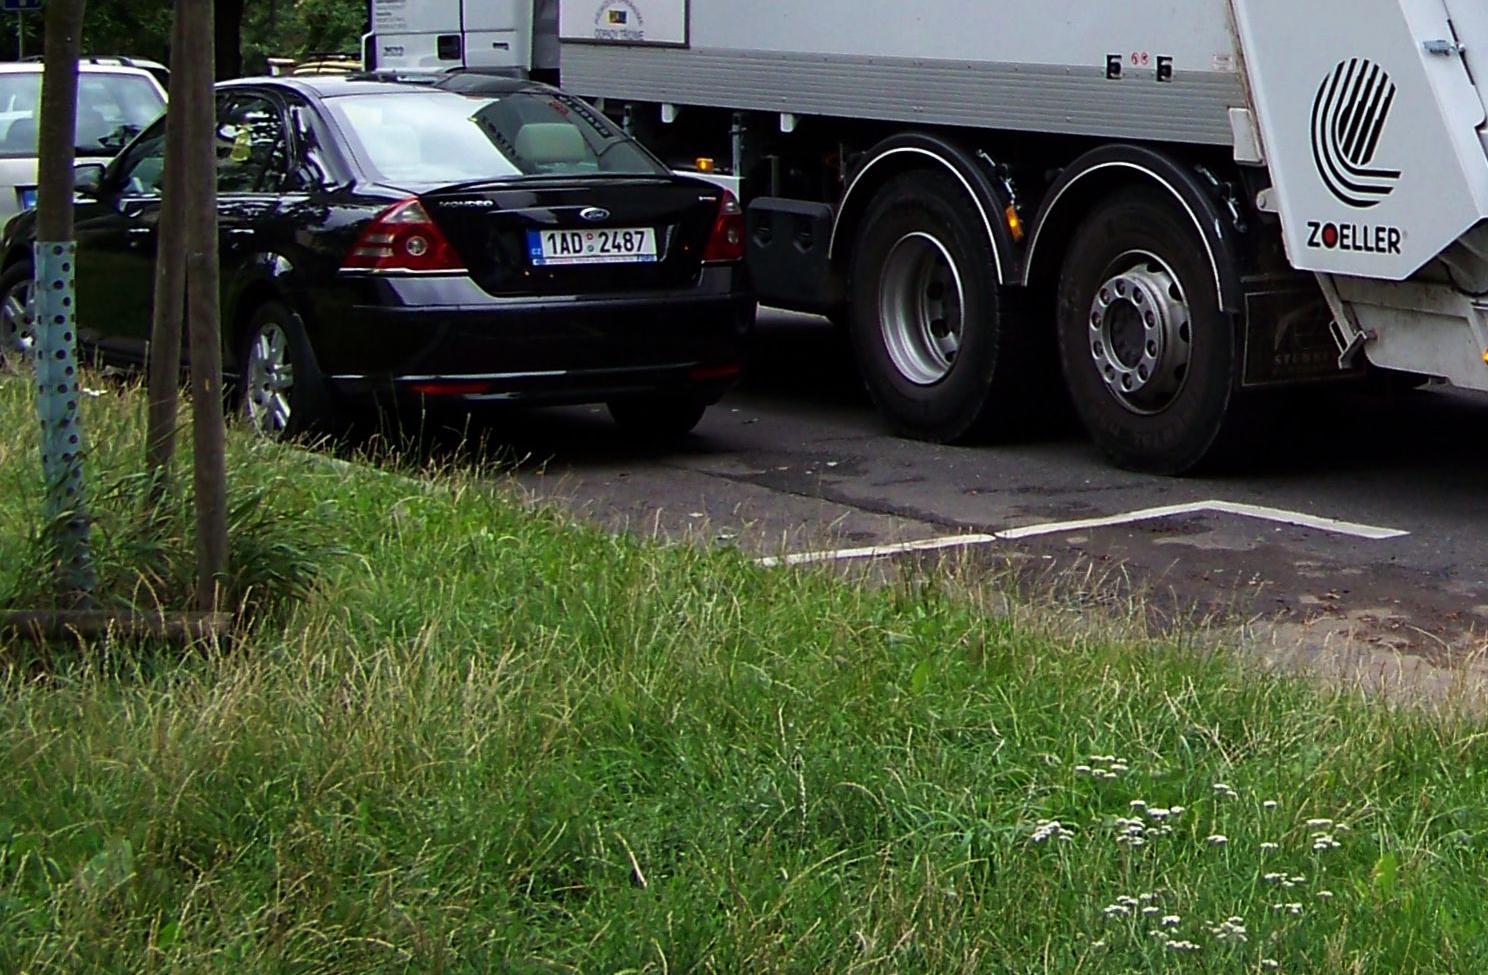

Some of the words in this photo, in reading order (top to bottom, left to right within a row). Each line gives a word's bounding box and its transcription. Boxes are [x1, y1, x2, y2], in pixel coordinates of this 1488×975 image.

[547, 232, 583, 255] 1AD
[598, 230, 645, 253] 2487
[1306, 221, 1401, 255] ZOELLER
